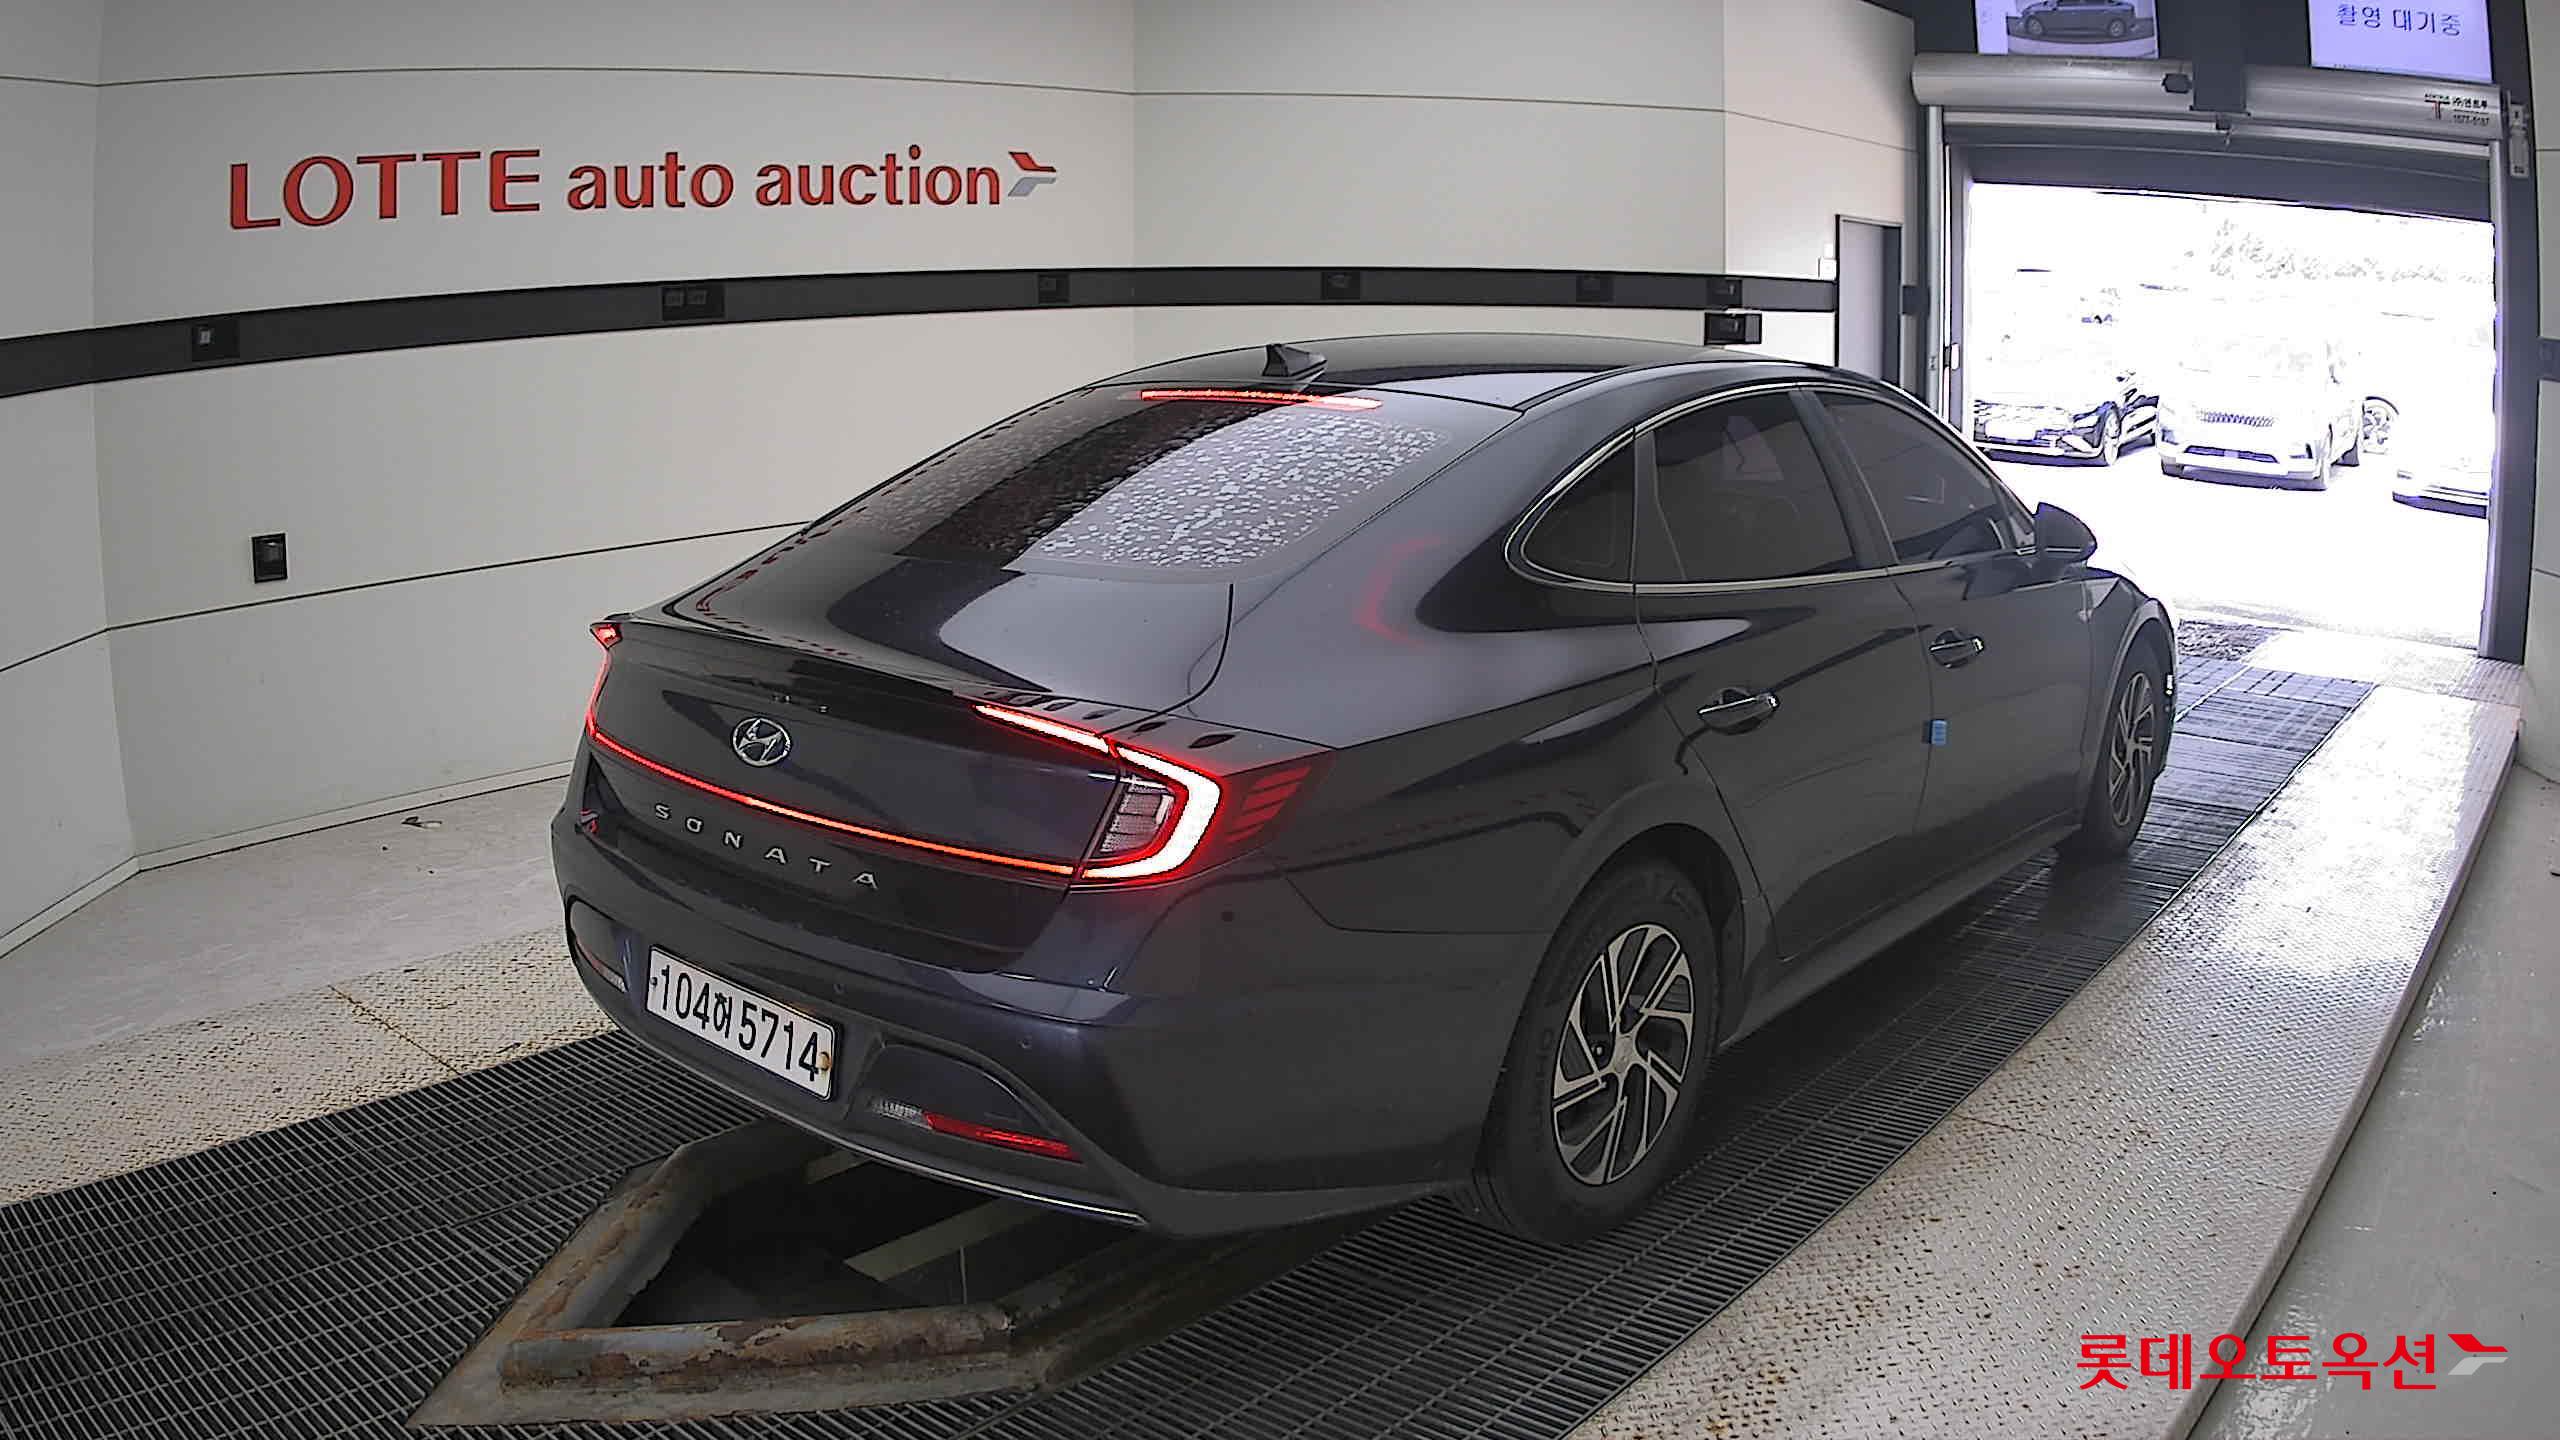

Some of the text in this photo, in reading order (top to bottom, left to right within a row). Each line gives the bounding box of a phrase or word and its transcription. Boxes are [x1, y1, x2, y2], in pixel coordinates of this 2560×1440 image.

[2337, 4, 2462, 37] 촬영 대기중
[230, 144, 1001, 230] LOTTE auto auction
[654, 803, 879, 890] SONATA
